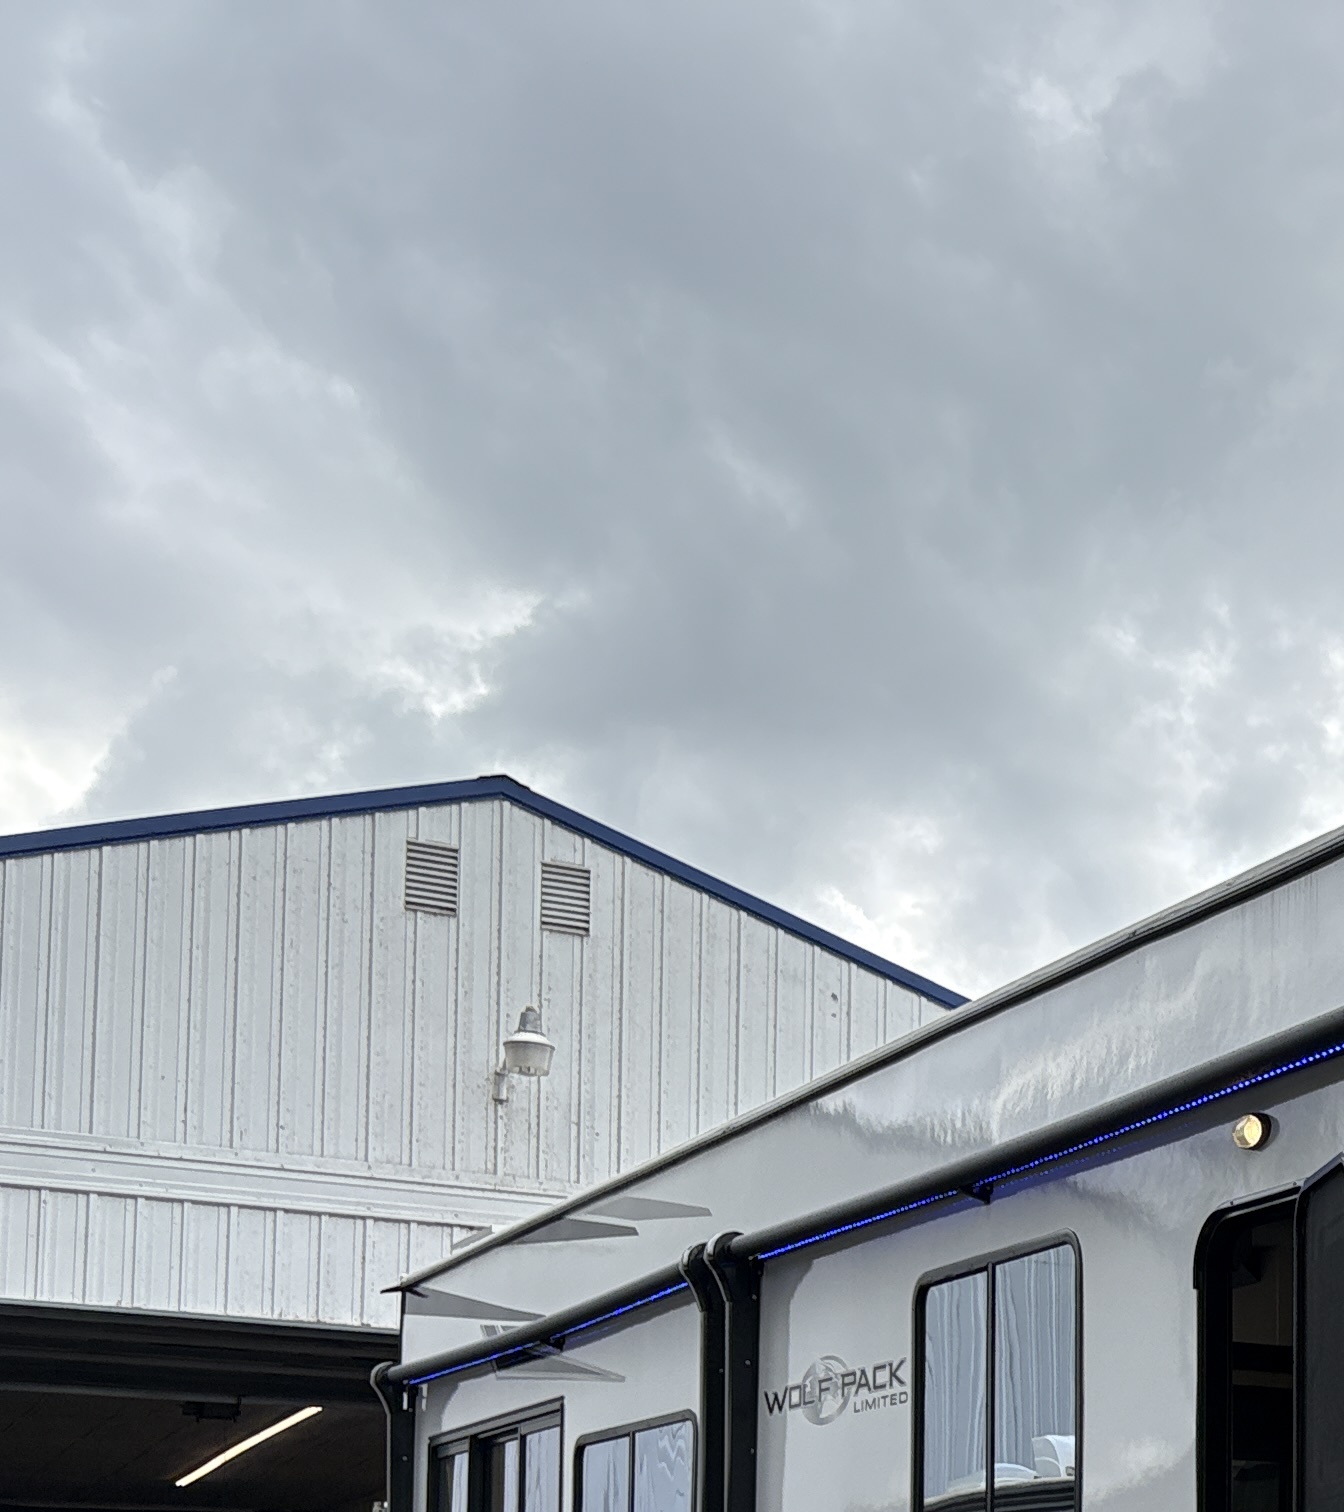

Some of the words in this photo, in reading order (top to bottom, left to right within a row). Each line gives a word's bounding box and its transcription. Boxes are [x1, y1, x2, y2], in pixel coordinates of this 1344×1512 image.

[764, 1376, 834, 1417] WOLF
[840, 1356, 907, 1399] PACK
[853, 1391, 909, 1414] LIMITED
